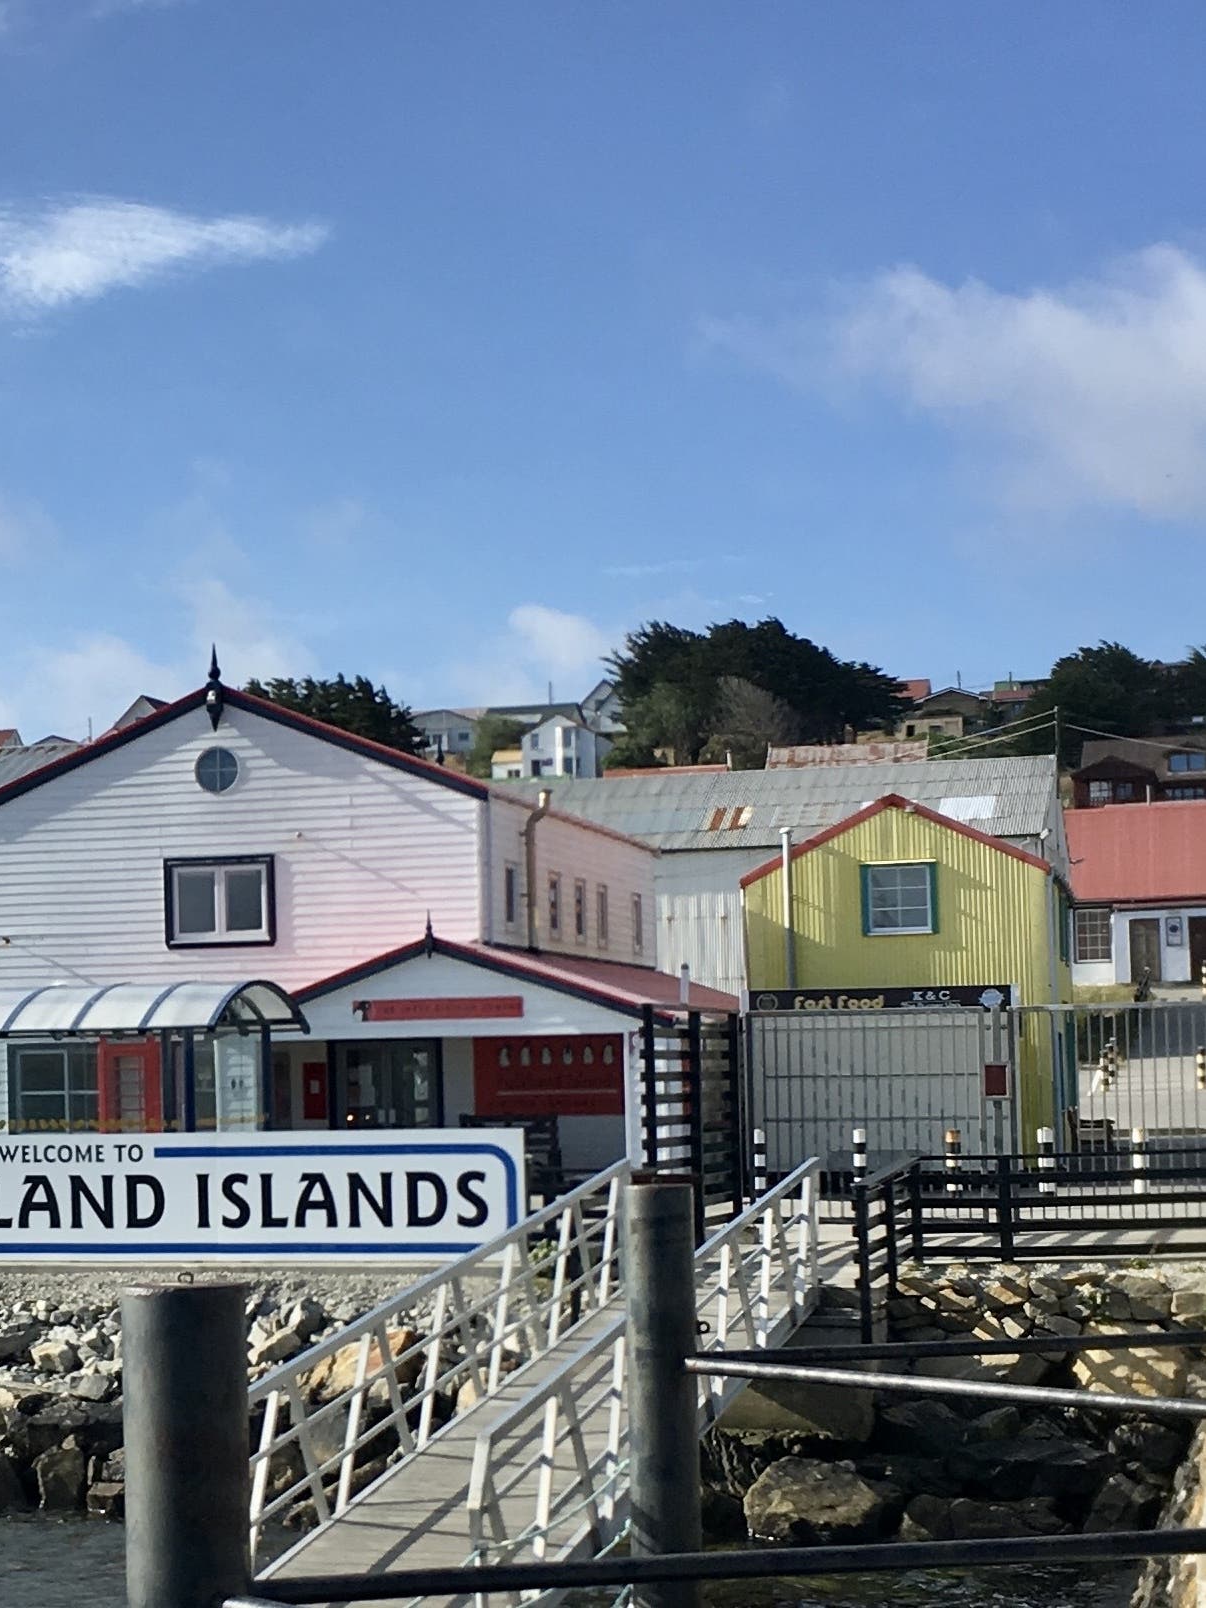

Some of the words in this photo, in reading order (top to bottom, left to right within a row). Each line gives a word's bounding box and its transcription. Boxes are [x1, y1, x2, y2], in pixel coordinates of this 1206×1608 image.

[837, 994, 884, 1010] Food
[114, 1145, 143, 1162] TO
[197, 1171, 488, 1228] ISLANDS
